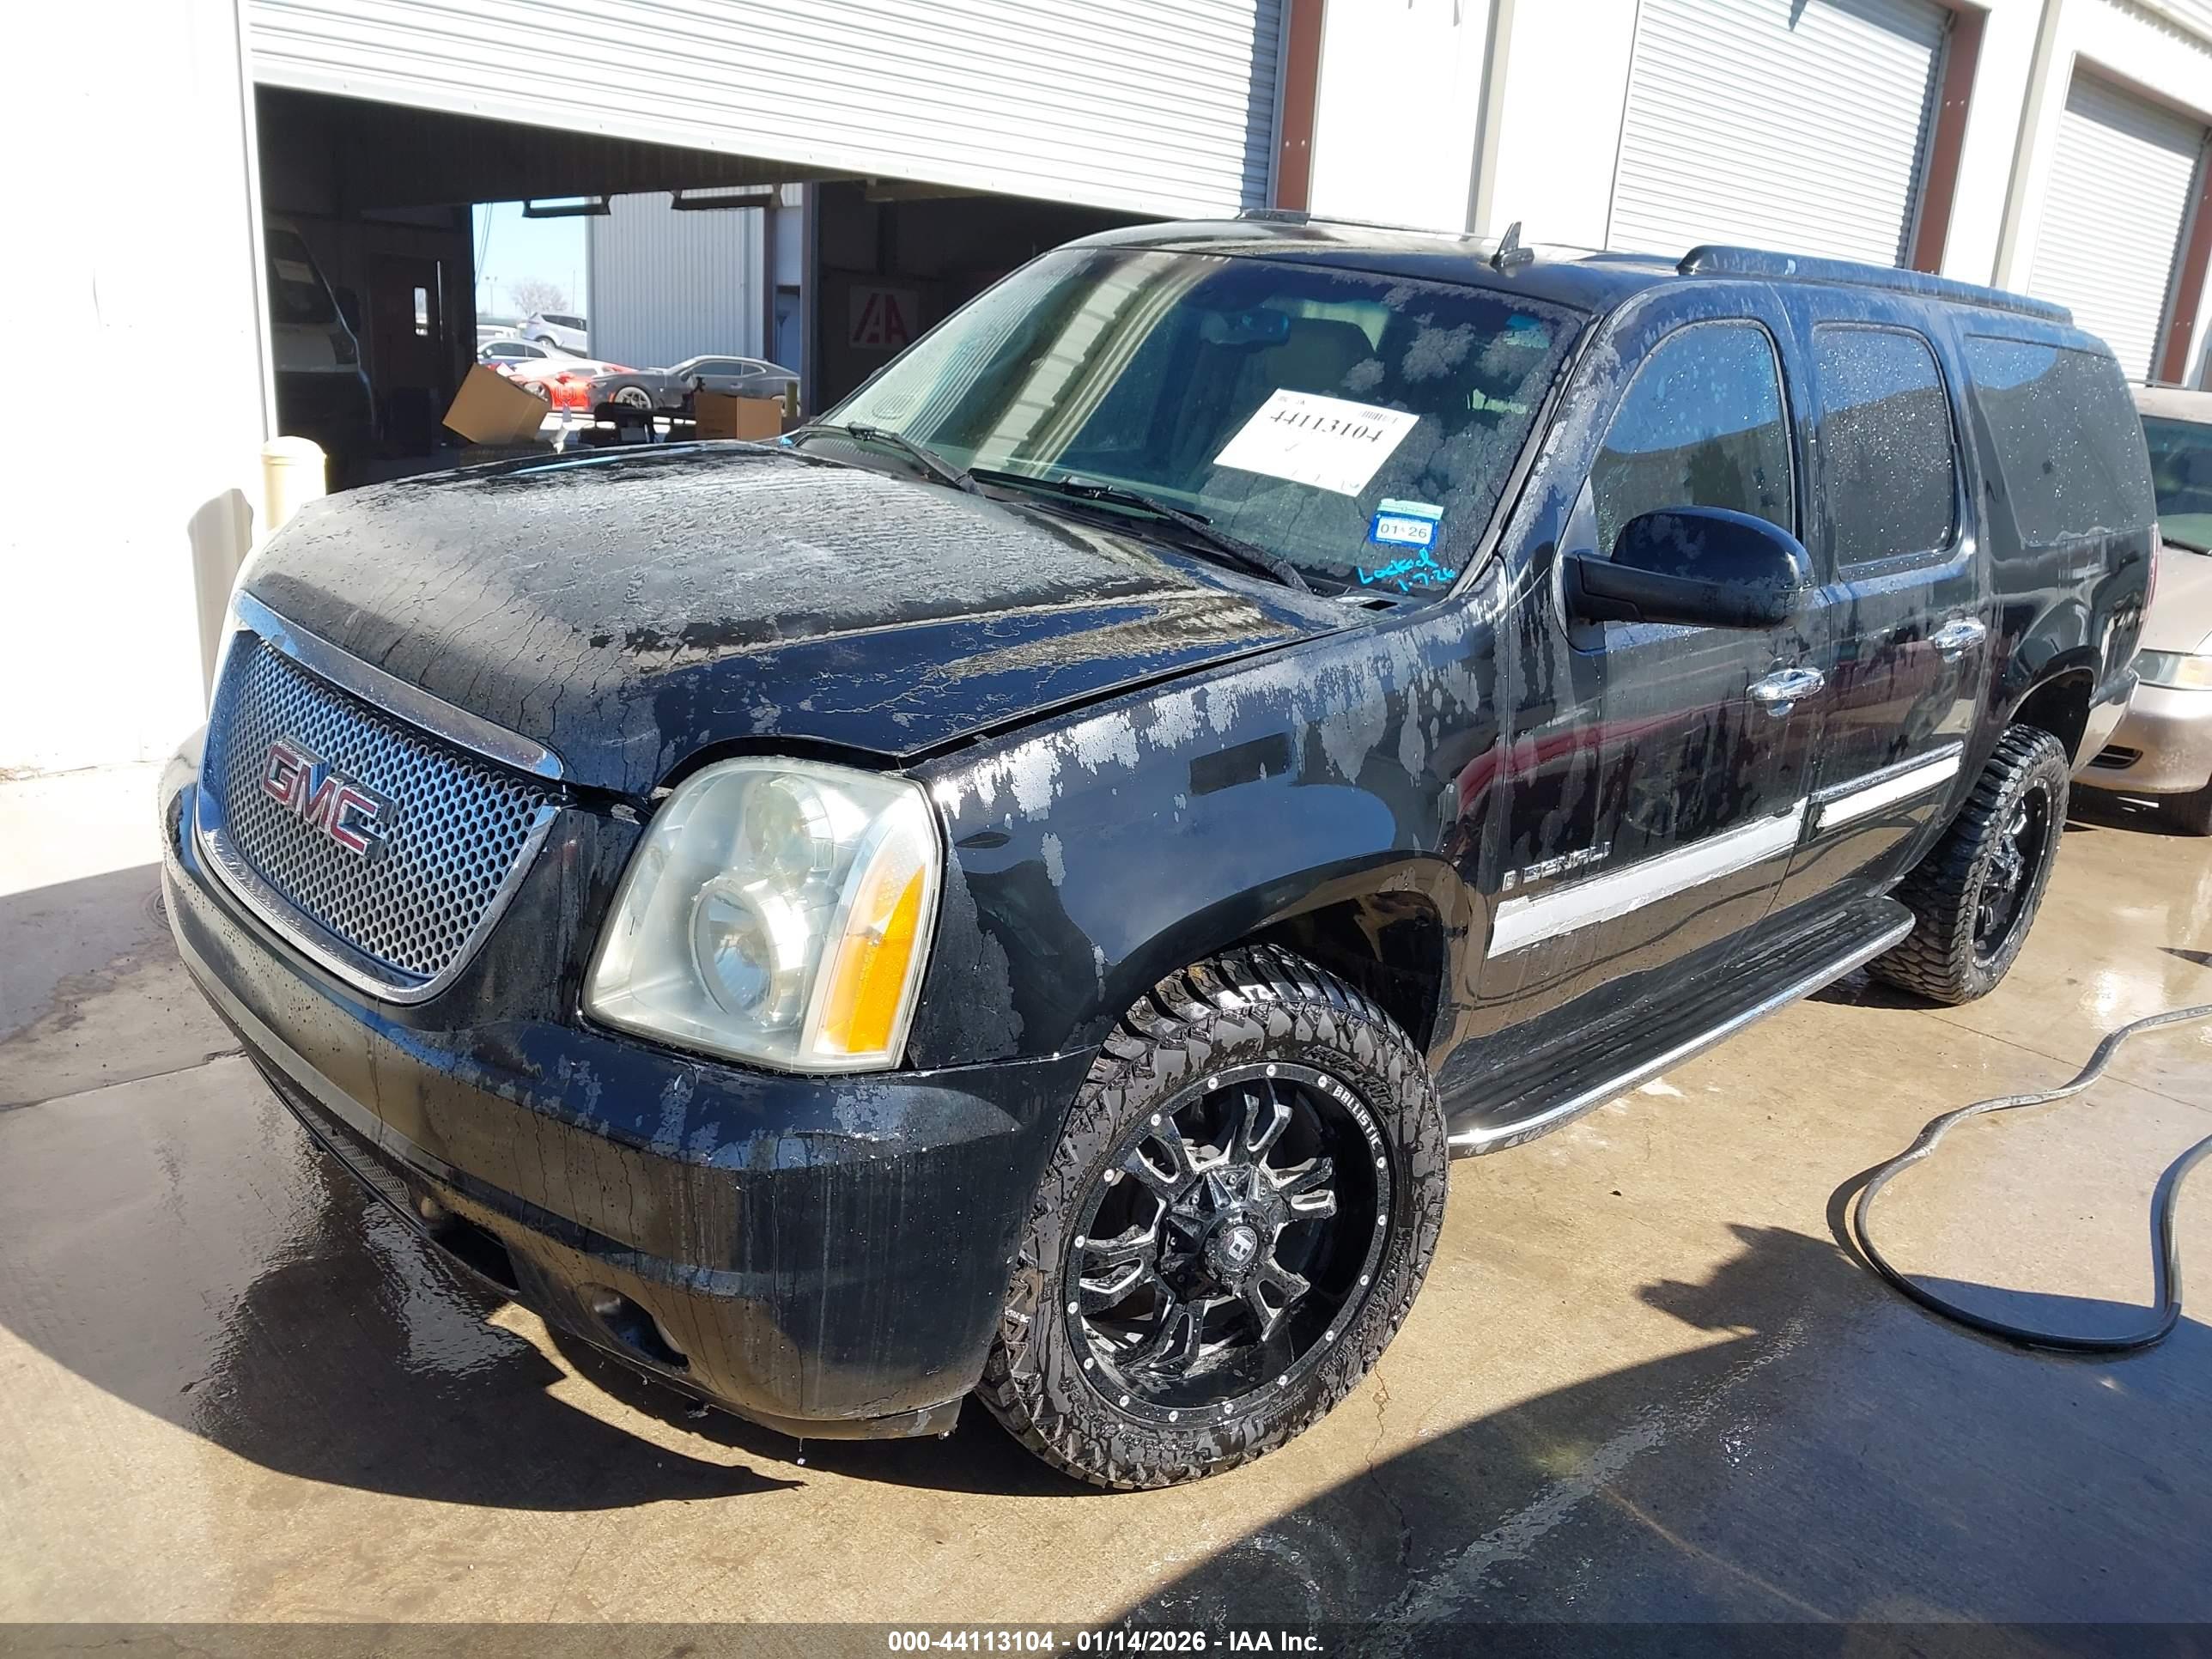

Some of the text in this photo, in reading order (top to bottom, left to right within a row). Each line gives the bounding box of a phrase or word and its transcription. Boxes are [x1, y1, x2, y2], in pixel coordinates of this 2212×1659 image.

[1270, 410, 1384, 443] 44113104
[1380, 523, 1428, 539] 01 26
[262, 739, 393, 860] GMC
[1522, 841, 1611, 884] DENALI
[1333, 1085, 1382, 1151] BALLISTIC
